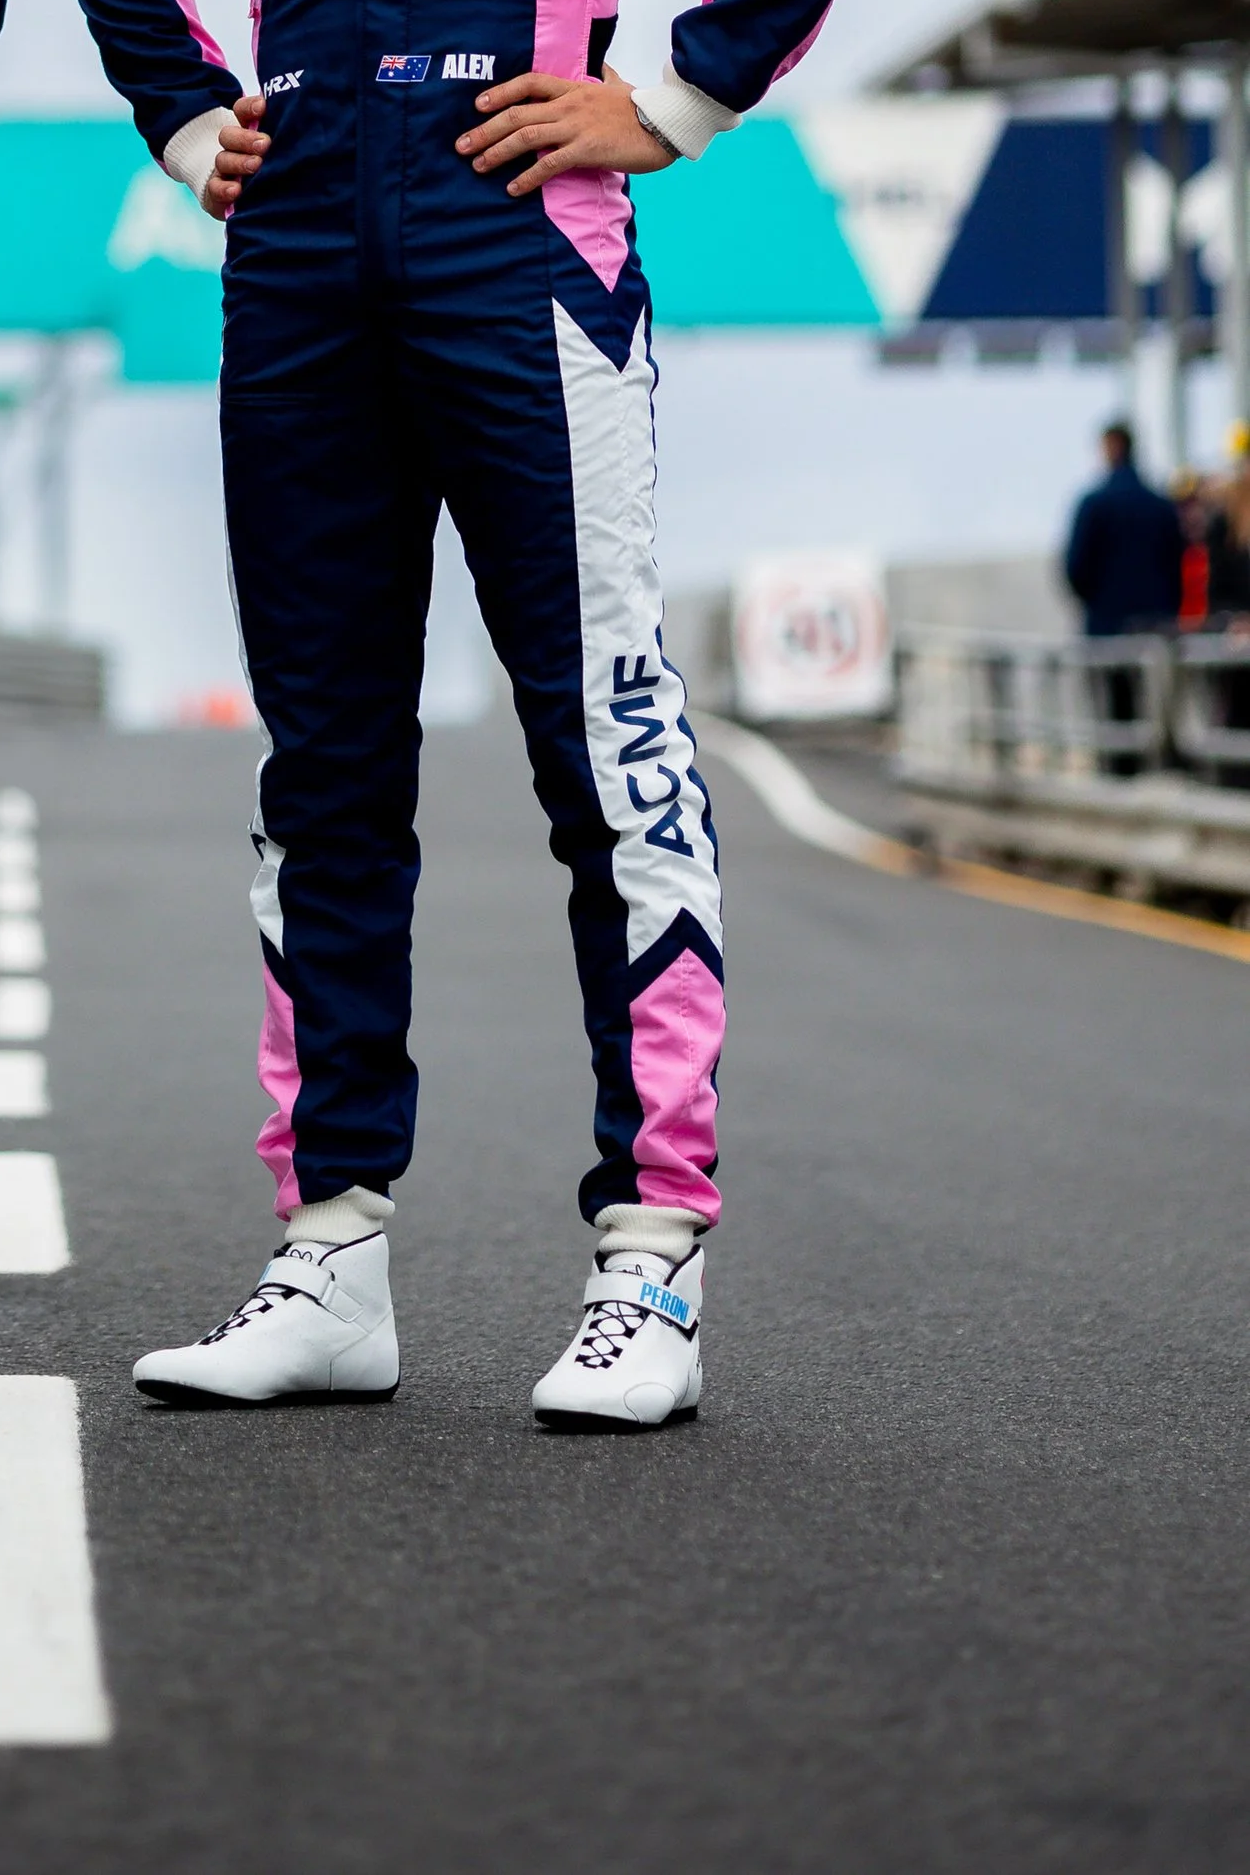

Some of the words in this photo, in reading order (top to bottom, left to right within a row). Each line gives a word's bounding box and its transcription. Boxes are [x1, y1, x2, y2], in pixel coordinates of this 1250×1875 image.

[263, 69, 304, 100] HRX
[441, 53, 496, 81] ALEX
[608, 654, 695, 859] ACMF
[639, 1281, 690, 1325] PERONI
